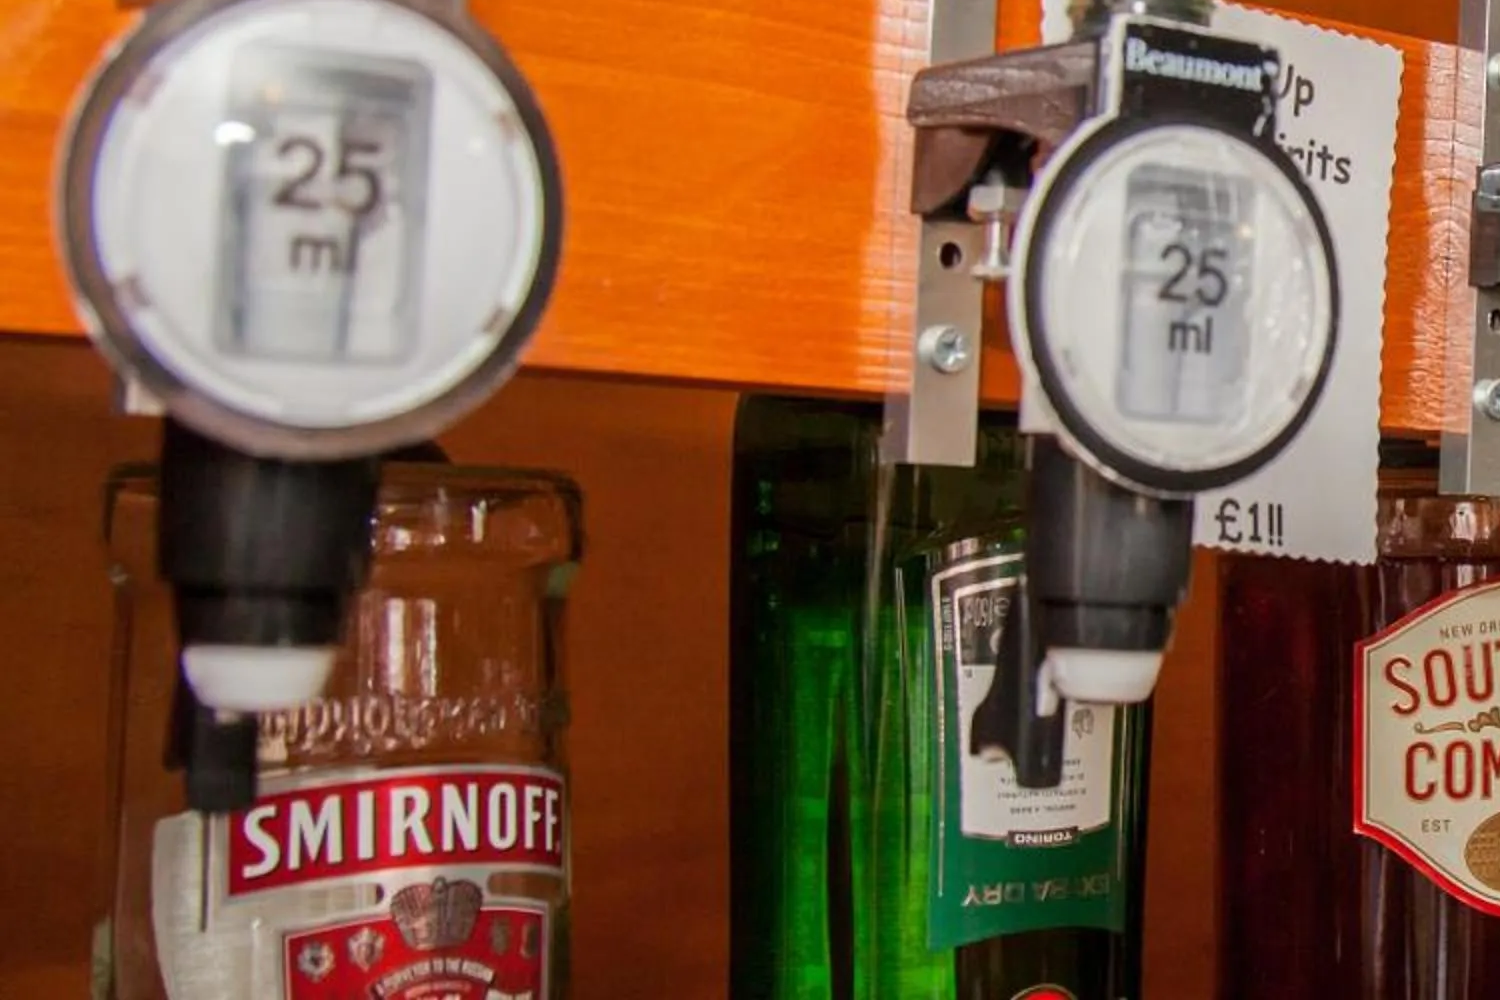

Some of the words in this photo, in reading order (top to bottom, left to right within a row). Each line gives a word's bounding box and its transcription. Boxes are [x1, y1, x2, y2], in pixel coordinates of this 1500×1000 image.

[1125, 36, 1266, 92] Beaumont
[272, 136, 384, 220] 25
[1157, 242, 1231, 308] 25
[1168, 318, 1214, 355] ml
[1215, 498, 1285, 548] £1!!
[1439, 623, 1473, 640] NEW
[241, 782, 559, 880] SMIRNOFF
[1014, 831, 1073, 846] TORINO
[1421, 818, 1452, 834] EST
